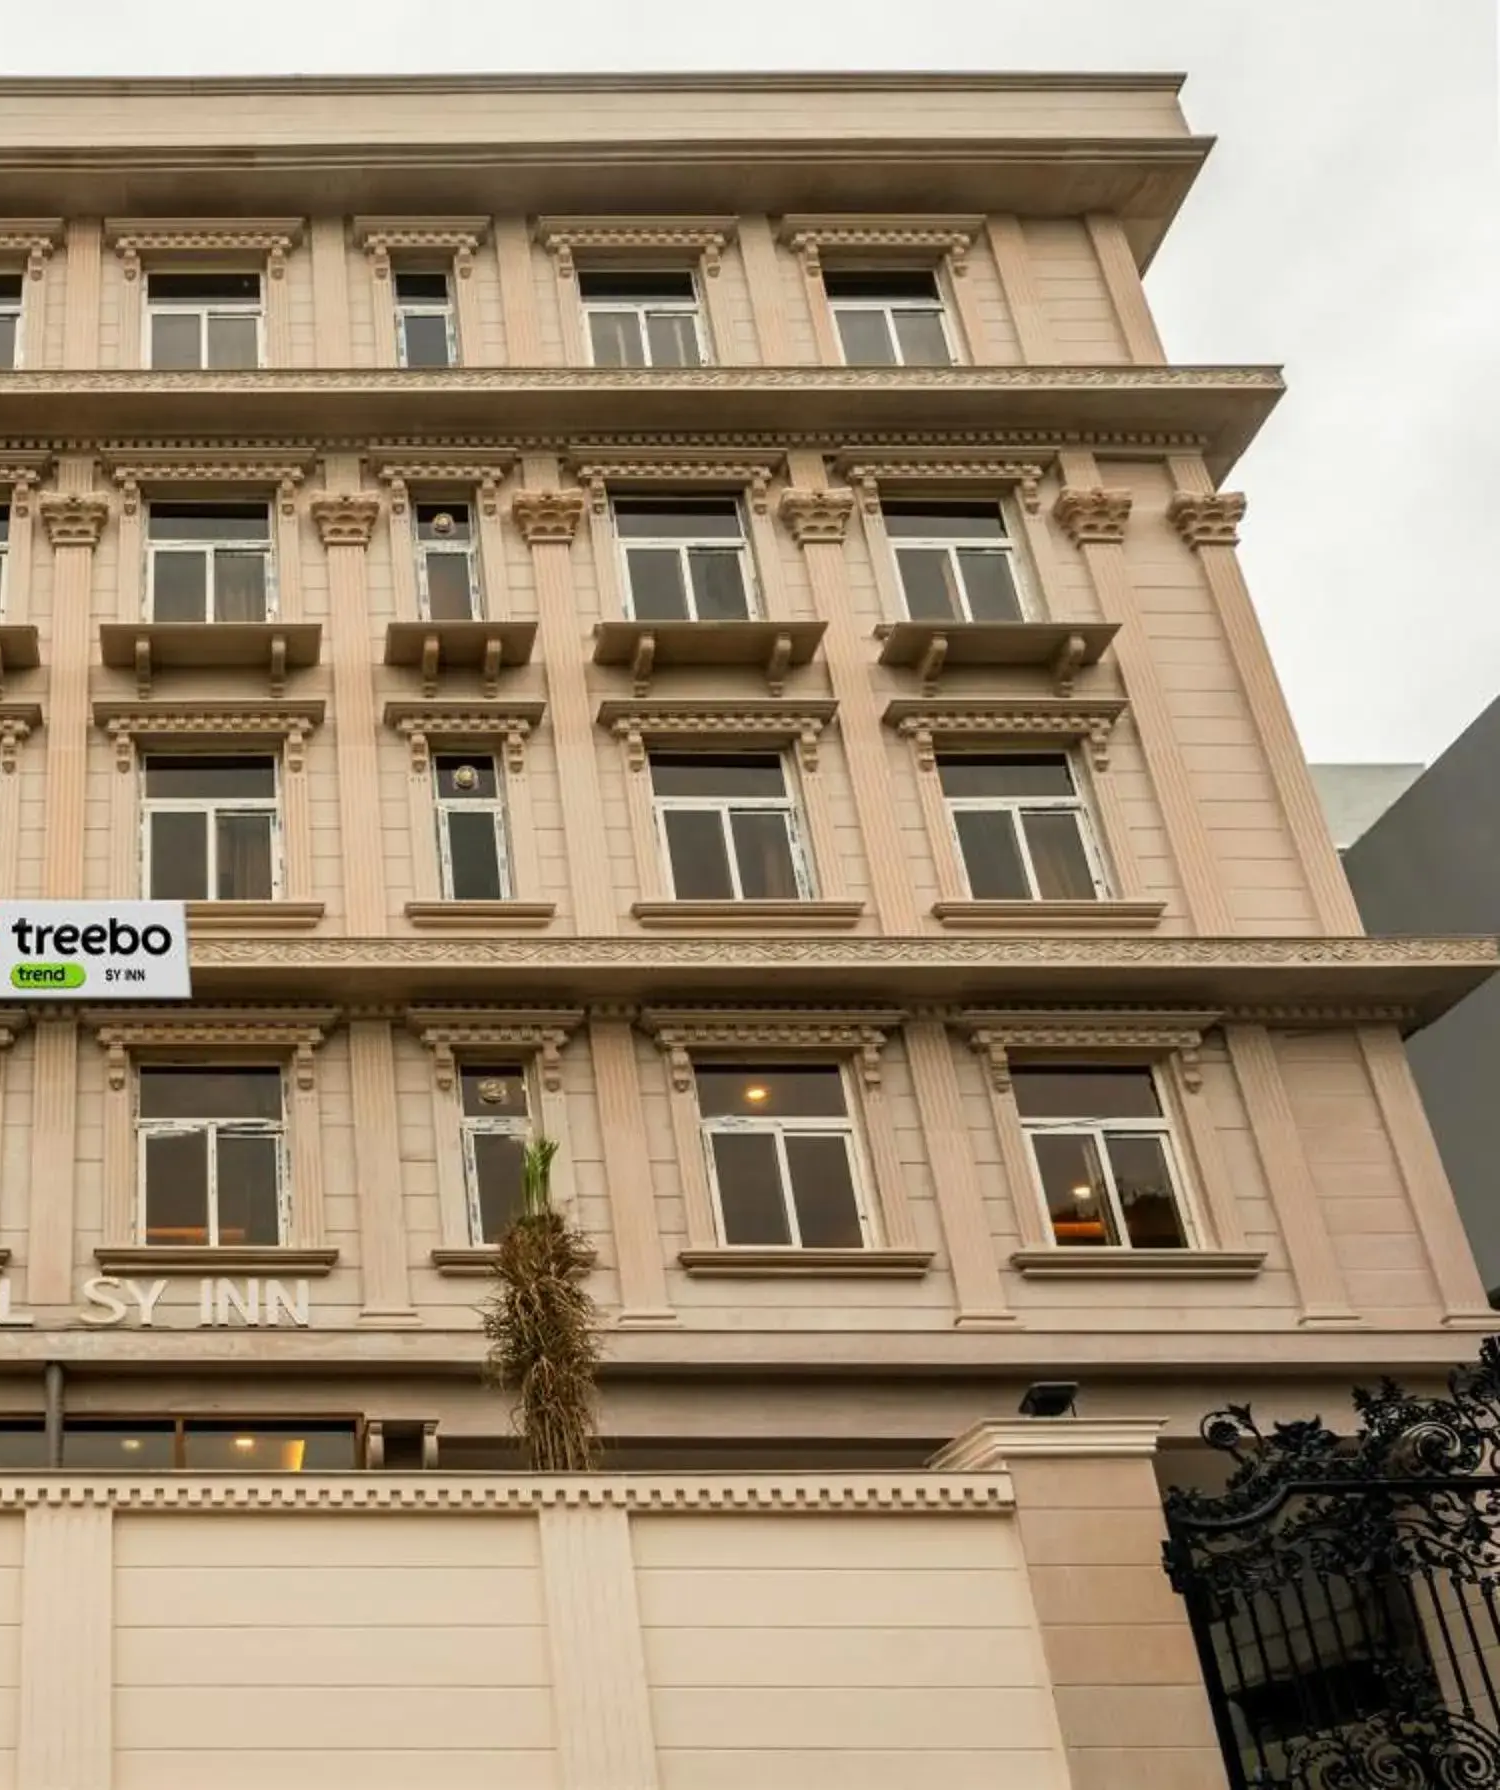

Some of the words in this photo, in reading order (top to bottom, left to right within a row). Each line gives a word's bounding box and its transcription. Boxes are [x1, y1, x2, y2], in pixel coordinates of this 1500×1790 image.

[11, 917, 172, 956] treebo
[17, 966, 66, 982] trend
[105, 968, 121, 981] SY
[124, 968, 146, 981] INN
[79, 1276, 167, 1327] SY
[200, 1278, 309, 1327] INN
